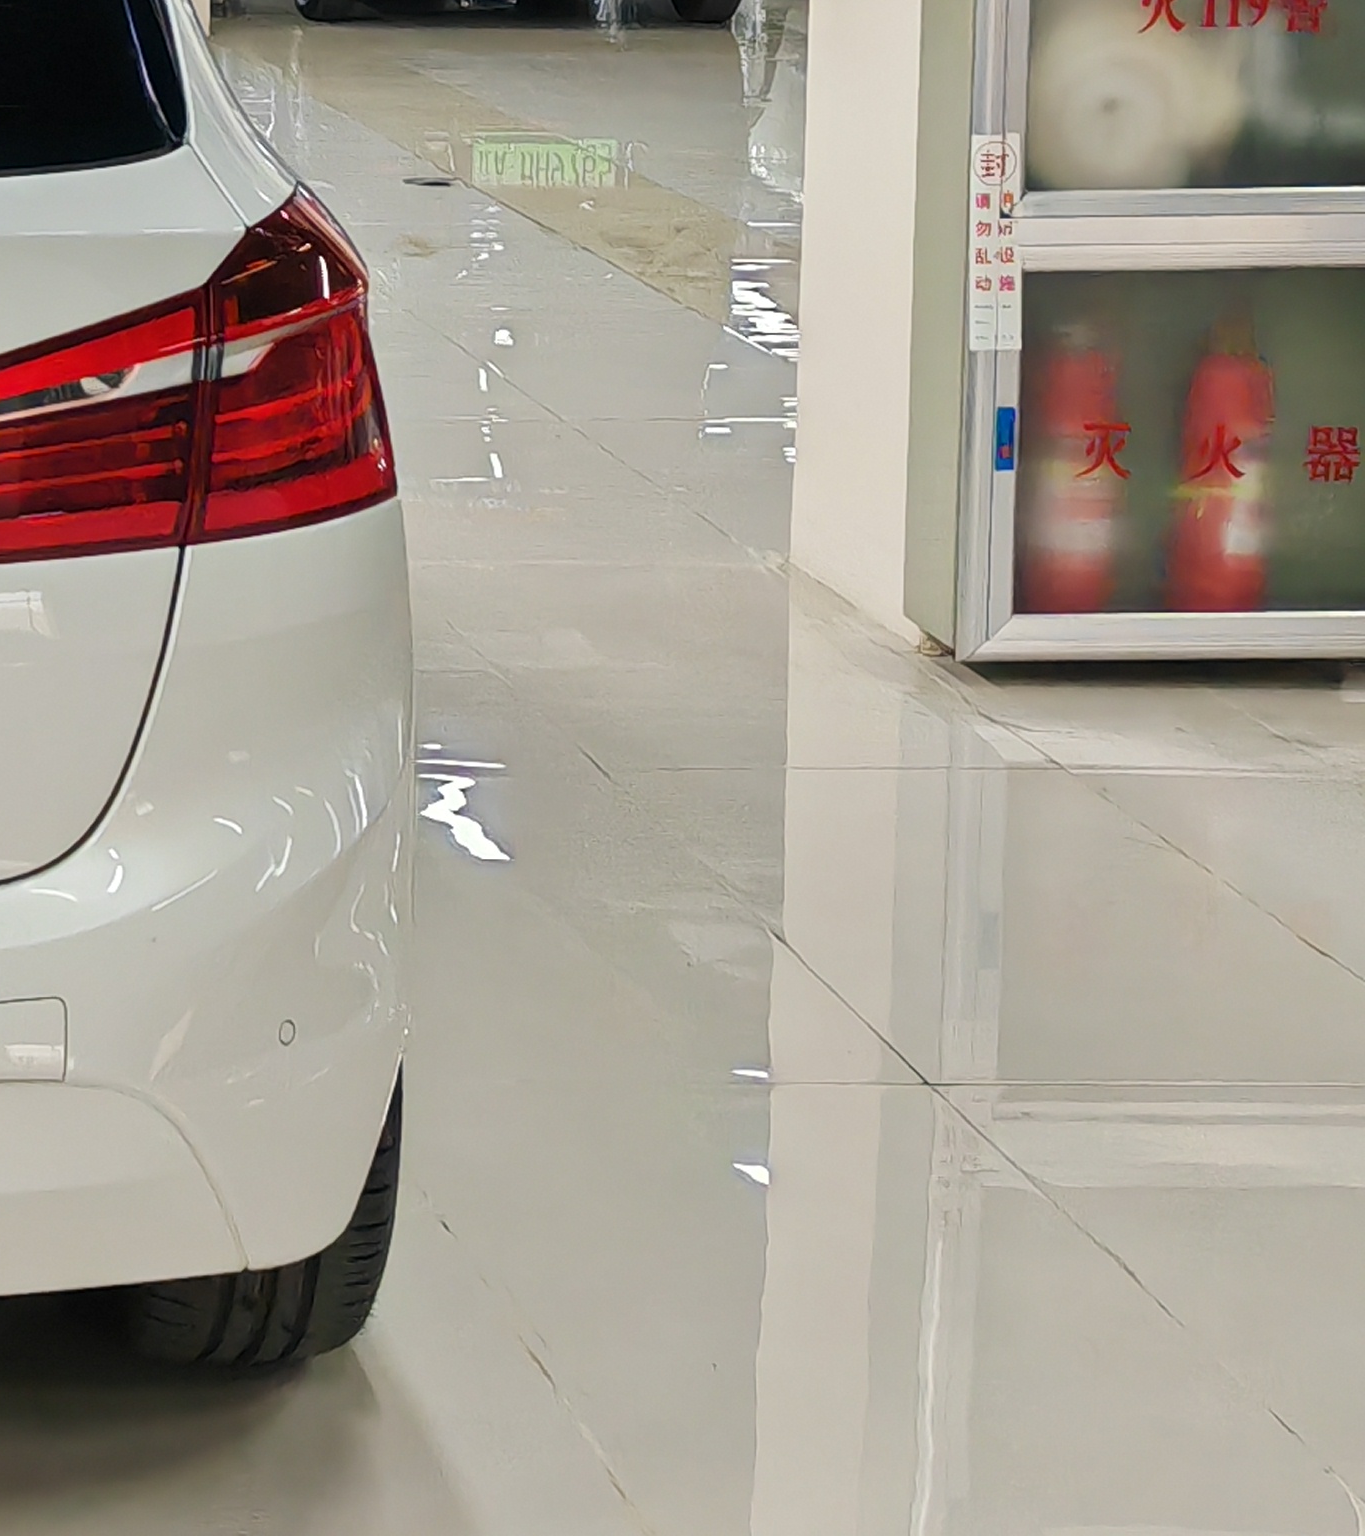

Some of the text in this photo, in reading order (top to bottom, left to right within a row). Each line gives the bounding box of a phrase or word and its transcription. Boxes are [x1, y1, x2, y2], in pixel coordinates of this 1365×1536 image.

[979, 148, 1010, 178] 封
[1074, 421, 1362, 484] 灭火器
